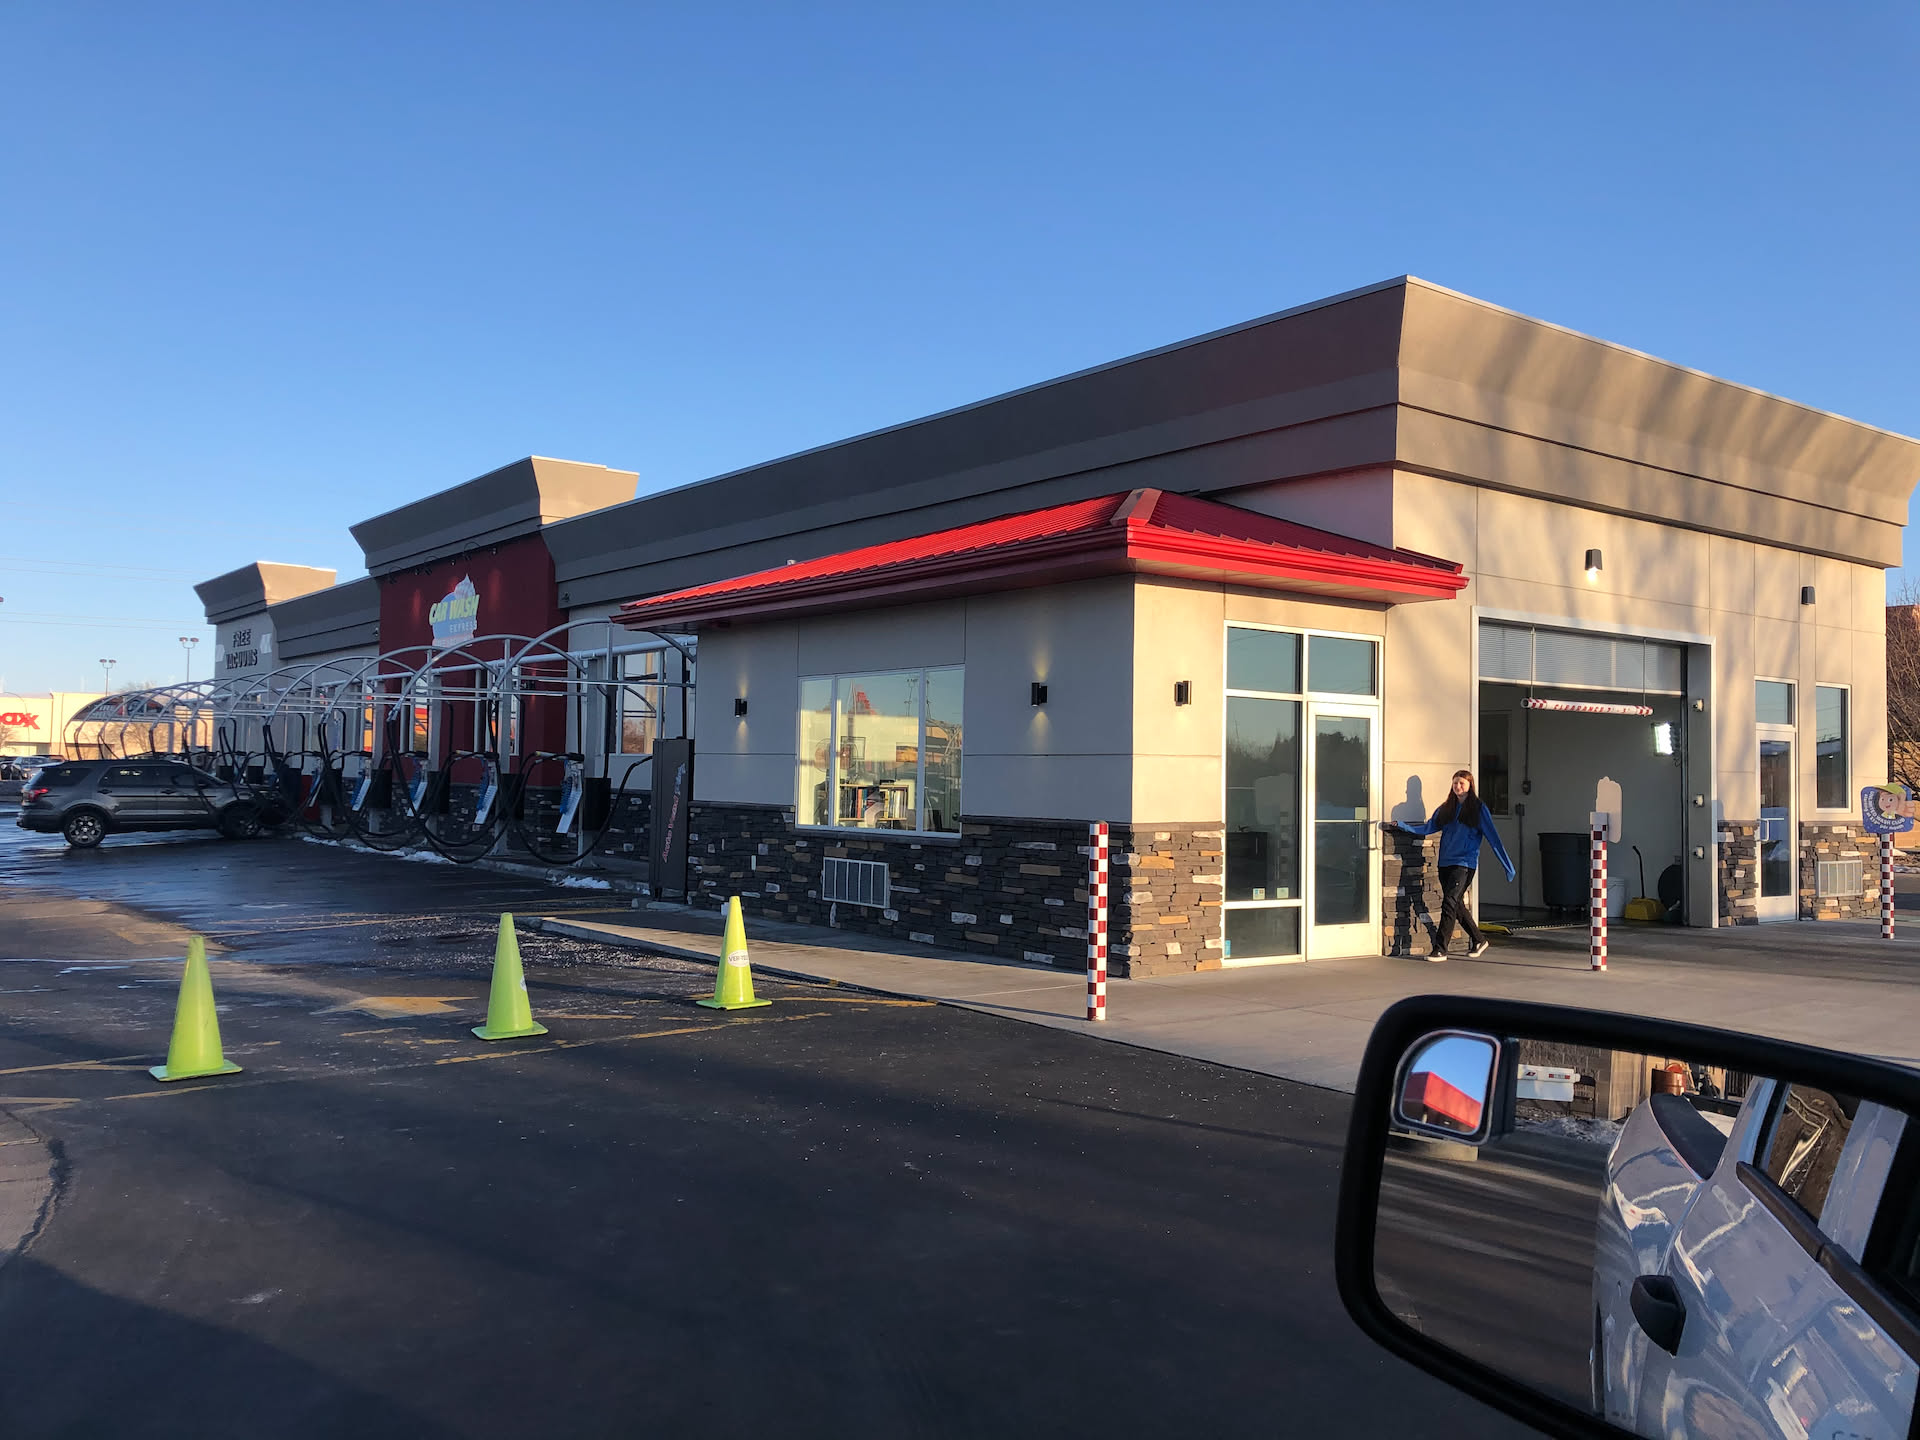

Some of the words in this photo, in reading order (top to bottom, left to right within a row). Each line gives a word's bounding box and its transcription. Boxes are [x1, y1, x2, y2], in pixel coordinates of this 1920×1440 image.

[429, 601, 449, 625] CAR
[449, 594, 480, 620] WASH
[450, 620, 478, 633] EXPRESS
[232, 628, 252, 648] FREE
[226, 649, 258, 669] VACUUMS
[1554, 704, 1604, 713] CLEARANCE
[1876, 816, 1890, 825] WASH
